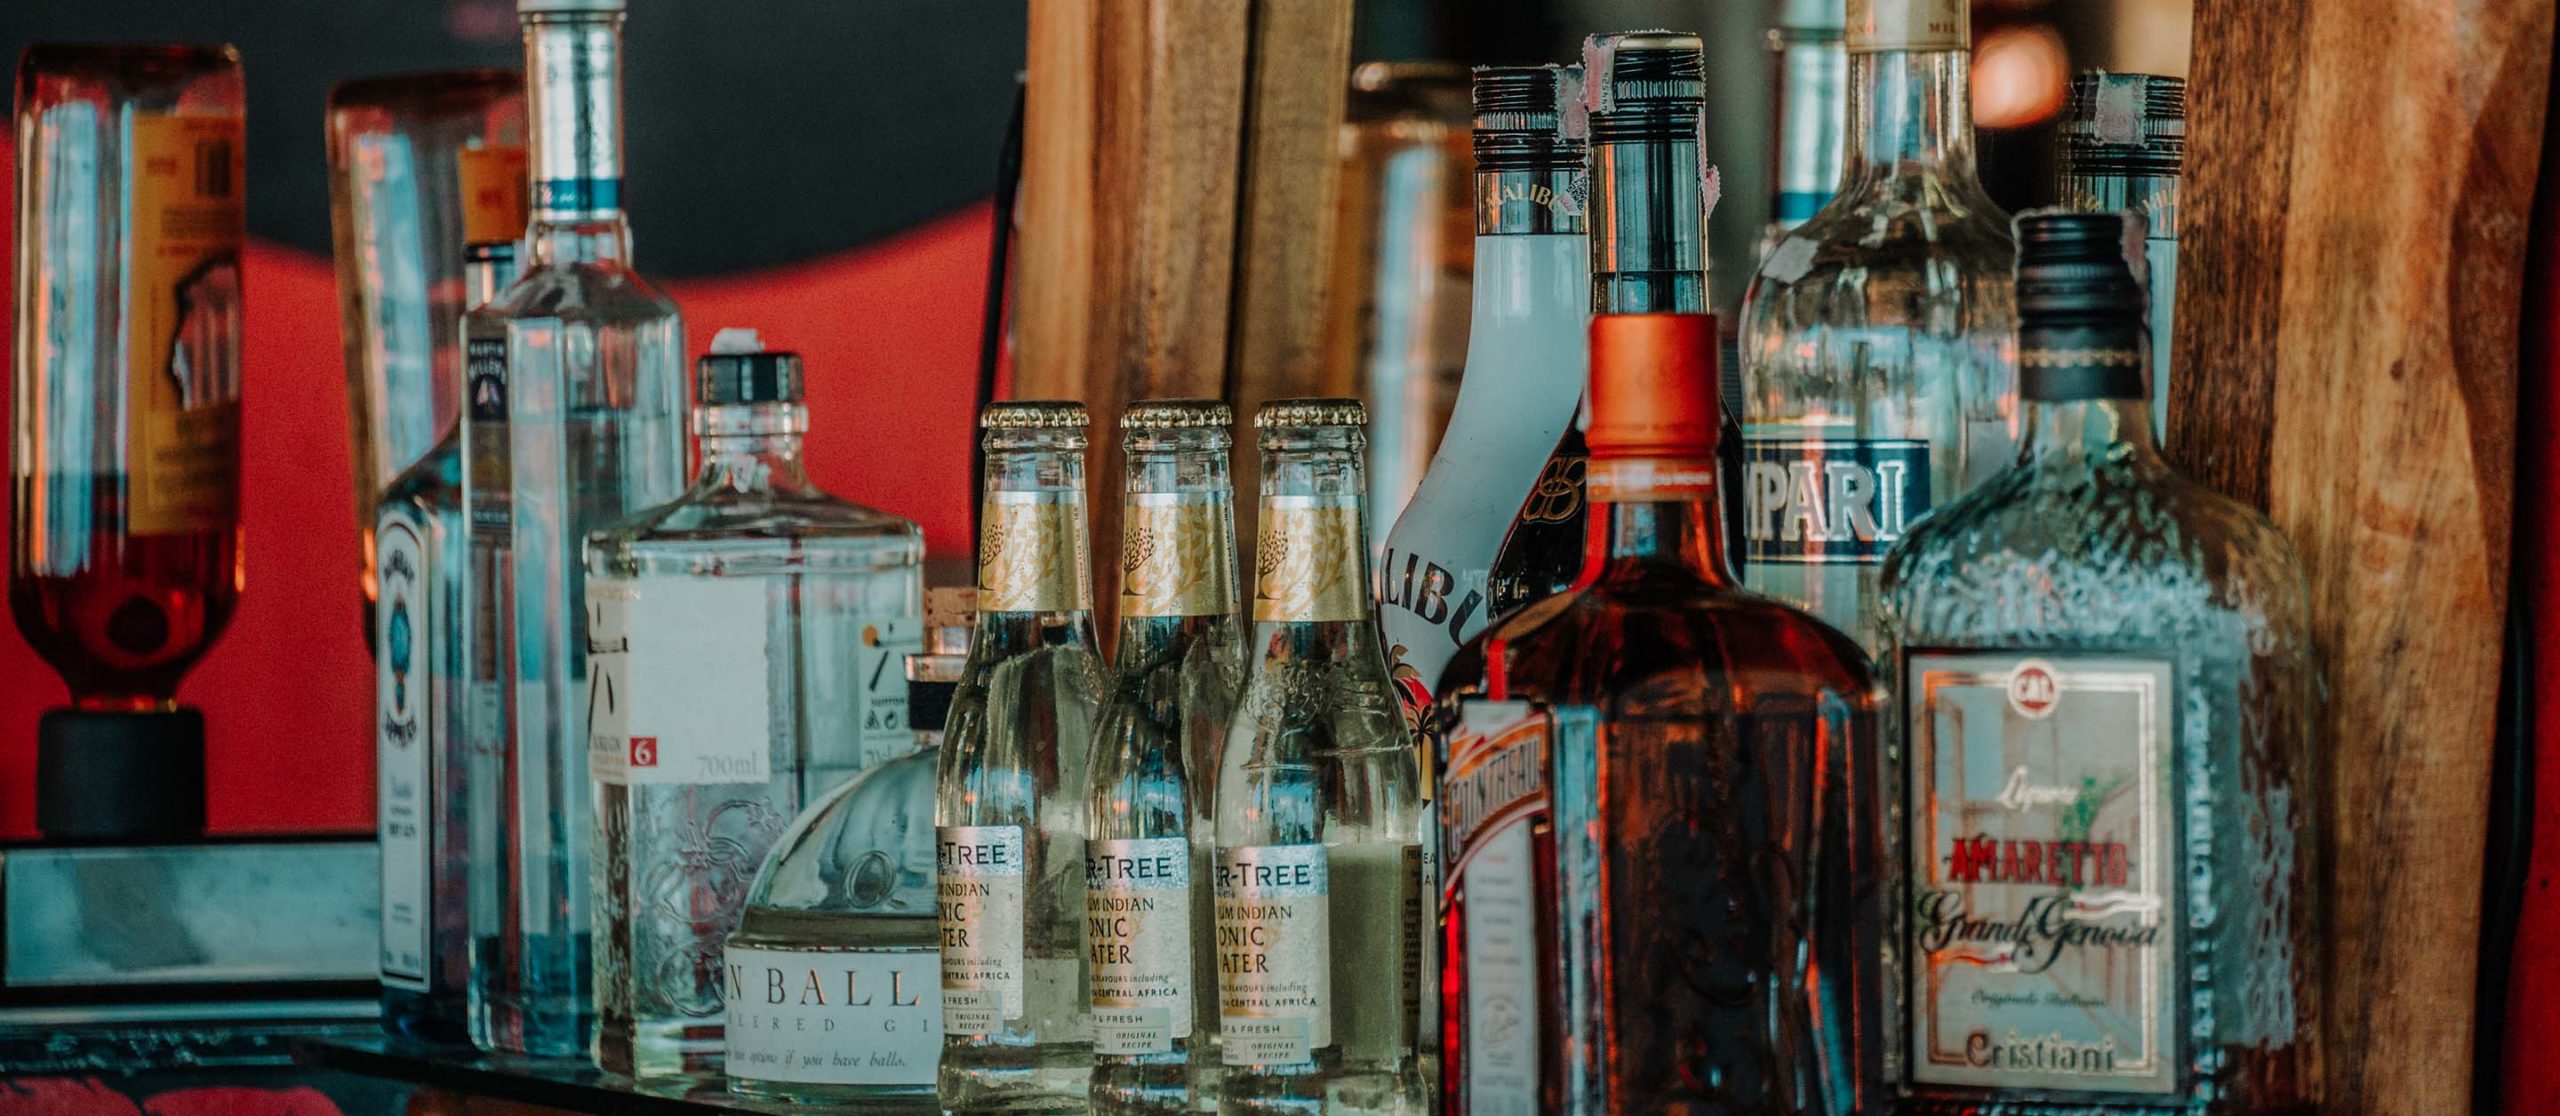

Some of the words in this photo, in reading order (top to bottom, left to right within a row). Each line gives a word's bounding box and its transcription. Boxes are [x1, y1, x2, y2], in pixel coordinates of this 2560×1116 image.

[635, 740, 650, 765] 6
[1949, 838, 2128, 887] AMARETTO
[1102, 898, 1154, 911] INDIAN
[1237, 906, 1292, 920] INDIAN
[974, 972, 1010, 980] AFRICA
[1130, 973, 1169, 984] including
[767, 967, 921, 1007] BALL
[1266, 982, 1308, 994] including
[1137, 988, 1178, 998] AFRICA
[1275, 998, 1317, 1007] AFRICA
[1106, 1015, 1143, 1024] FRESH
[1116, 1031, 1157, 1040] ORIGINAL
[1240, 1025, 1280, 1035] FRESH
[1121, 1040, 1153, 1049] RECIPE
[1966, 1027, 2115, 1071] Cristiani
[801, 1055, 823, 1069] you
[832, 1049, 860, 1067] have
